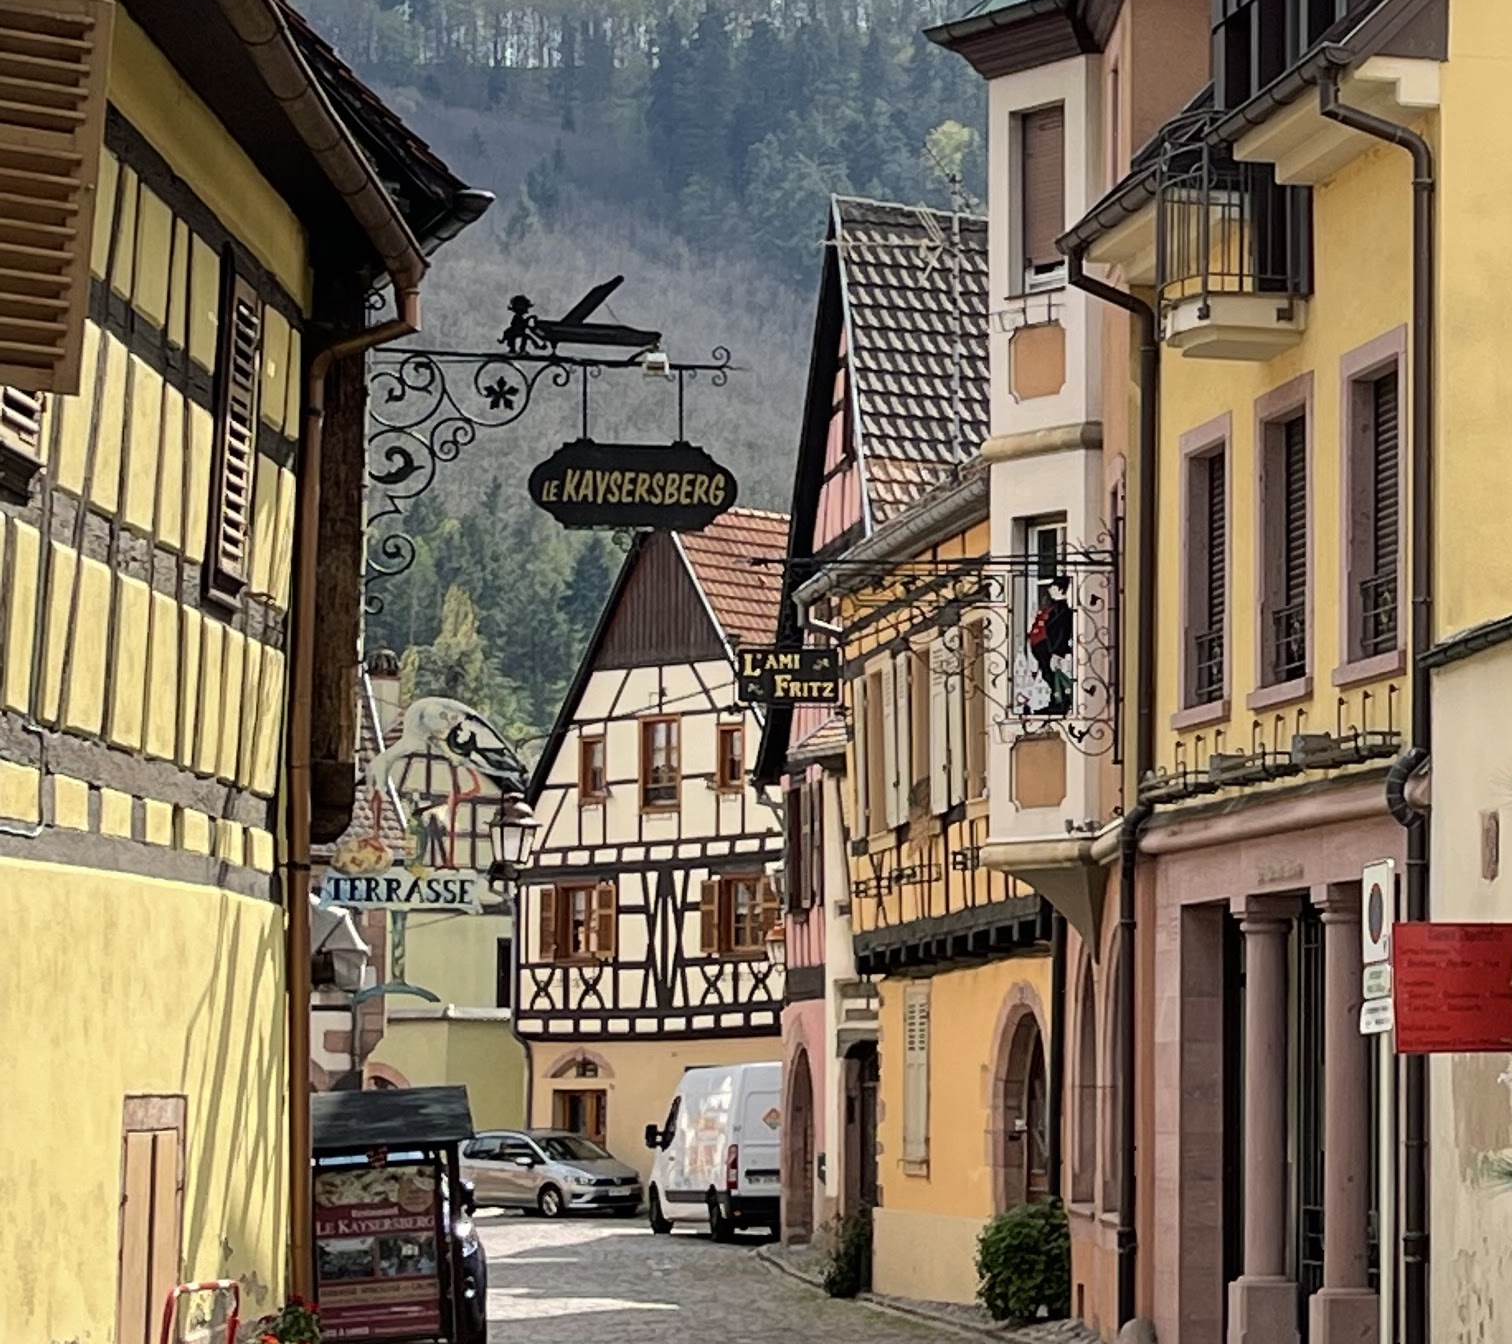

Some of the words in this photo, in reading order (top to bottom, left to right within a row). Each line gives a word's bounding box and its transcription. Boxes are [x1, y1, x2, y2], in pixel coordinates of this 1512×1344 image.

[541, 480, 561, 502] LE
[562, 469, 726, 506] KAYSERSBERG
[742, 653, 801, 677] L'AMI
[773, 674, 835, 698] FRITZ
[327, 876, 476, 905] TERRASSE
[338, 1215, 435, 1235] KAYSERSBERG
